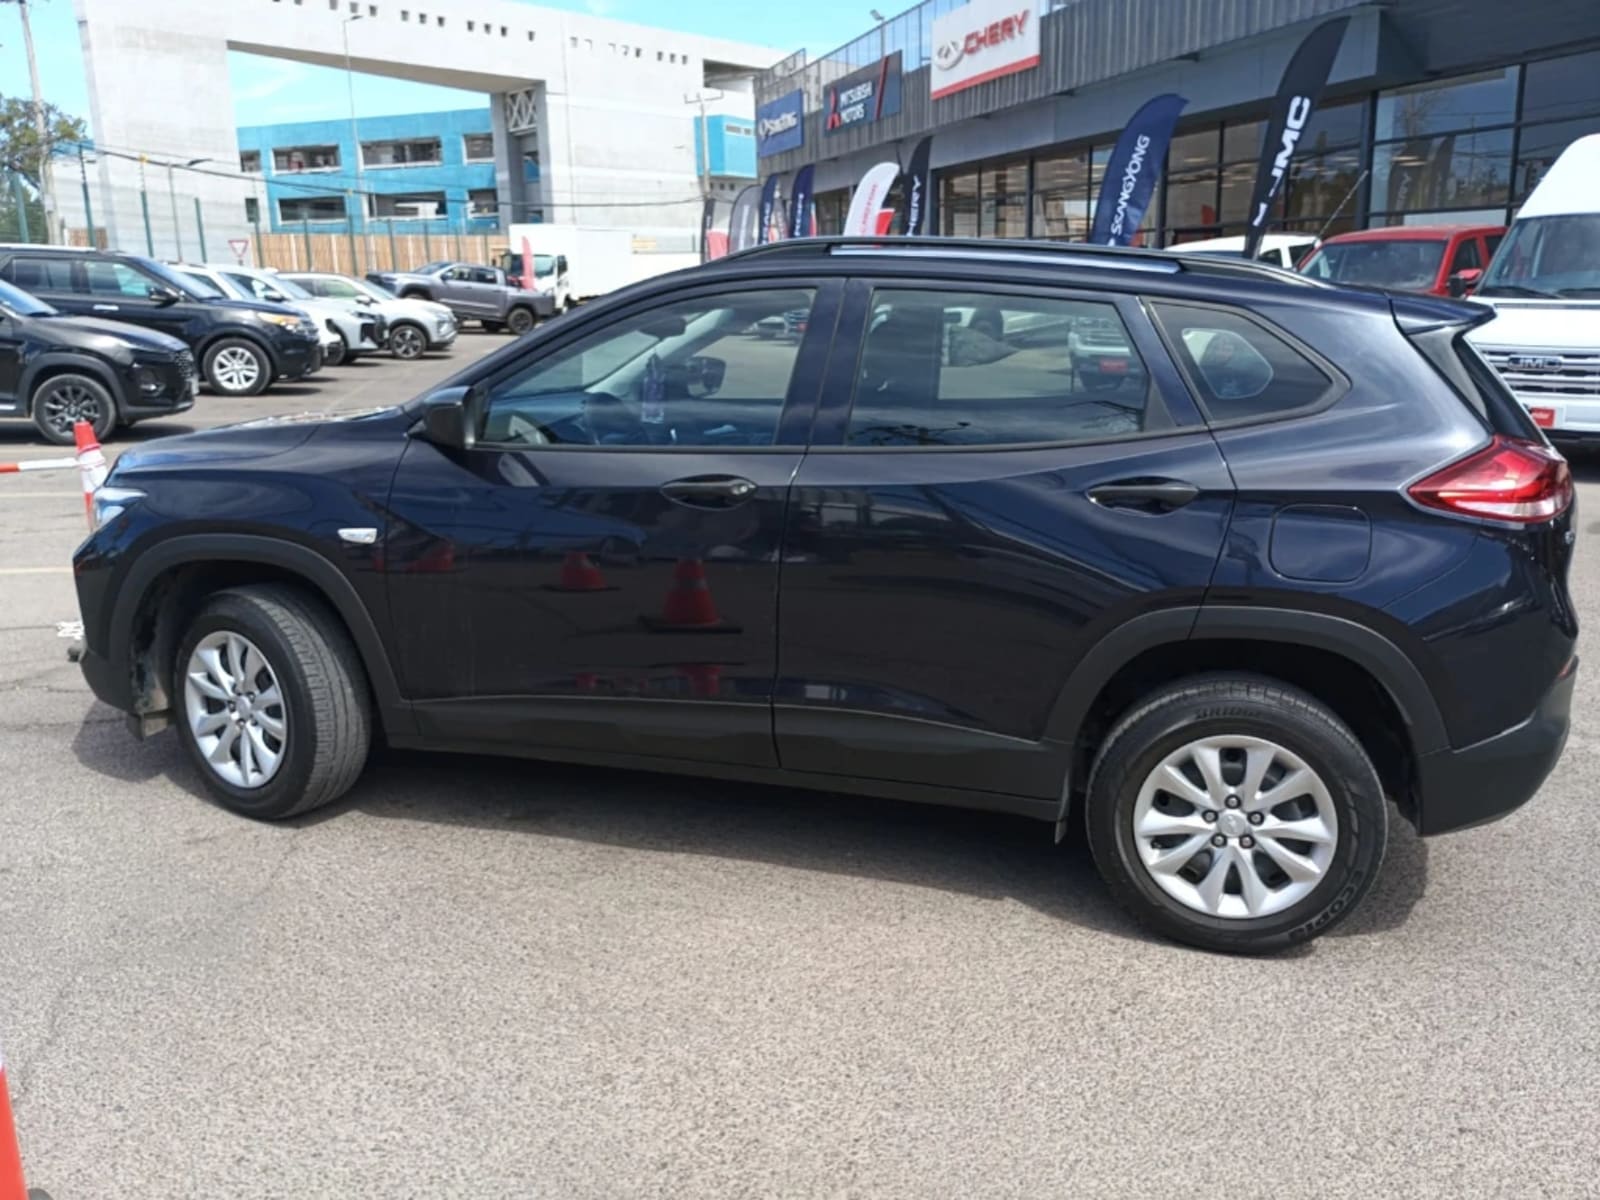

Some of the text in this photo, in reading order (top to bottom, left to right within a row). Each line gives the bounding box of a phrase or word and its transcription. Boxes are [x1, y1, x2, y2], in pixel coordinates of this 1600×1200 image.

[964, 9, 1030, 55] CHERY
[1110, 134, 1151, 236] SSANGYONG
[1268, 96, 1311, 198] JMC
[906, 175, 921, 237] HERY
